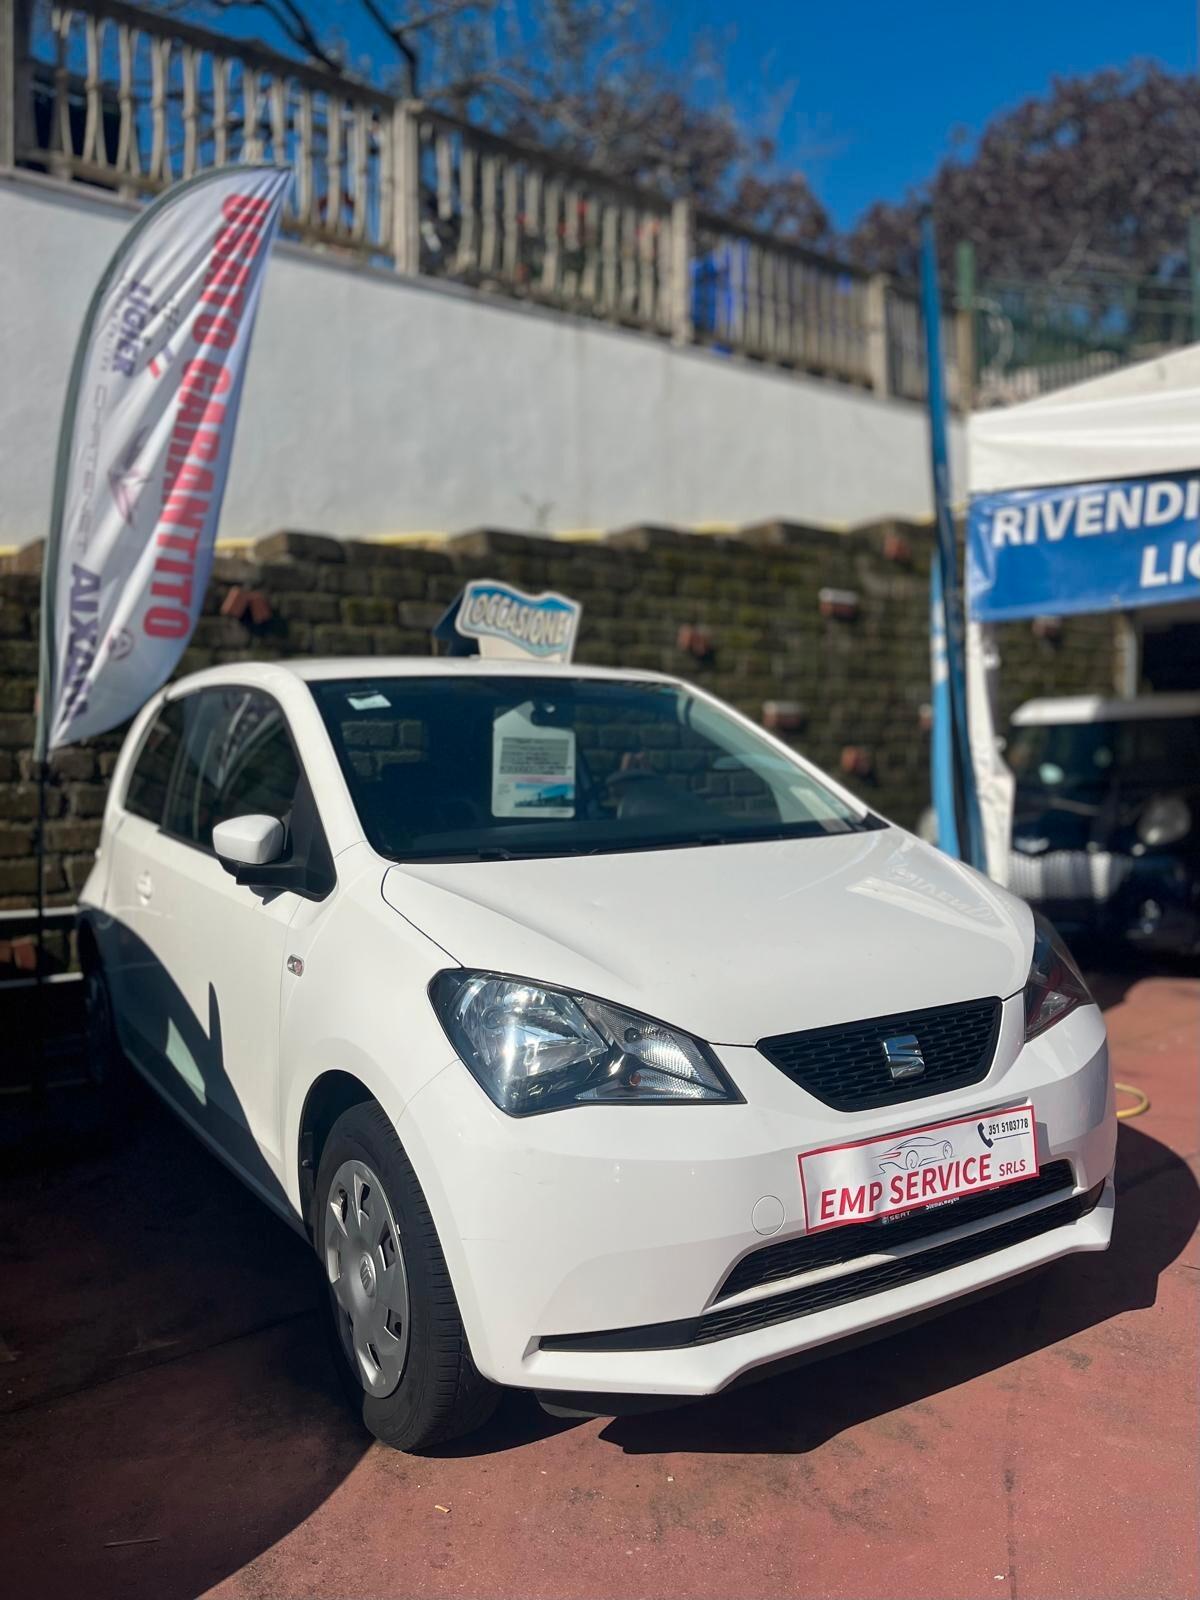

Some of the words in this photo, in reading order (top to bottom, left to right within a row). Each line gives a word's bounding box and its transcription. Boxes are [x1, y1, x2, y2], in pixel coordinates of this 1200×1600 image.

[191, 193, 272, 351] USATO
[143, 358, 232, 640] GARANTITO
[991, 479, 1200, 548] RIVENDI
[988, 1123, 1000, 1136] 351
[1001, 1117, 1029, 1133] 5103778
[820, 1181, 883, 1220] EMP
[889, 1153, 992, 1205] SERVICE
[999, 1159, 1026, 1177] SRLS
